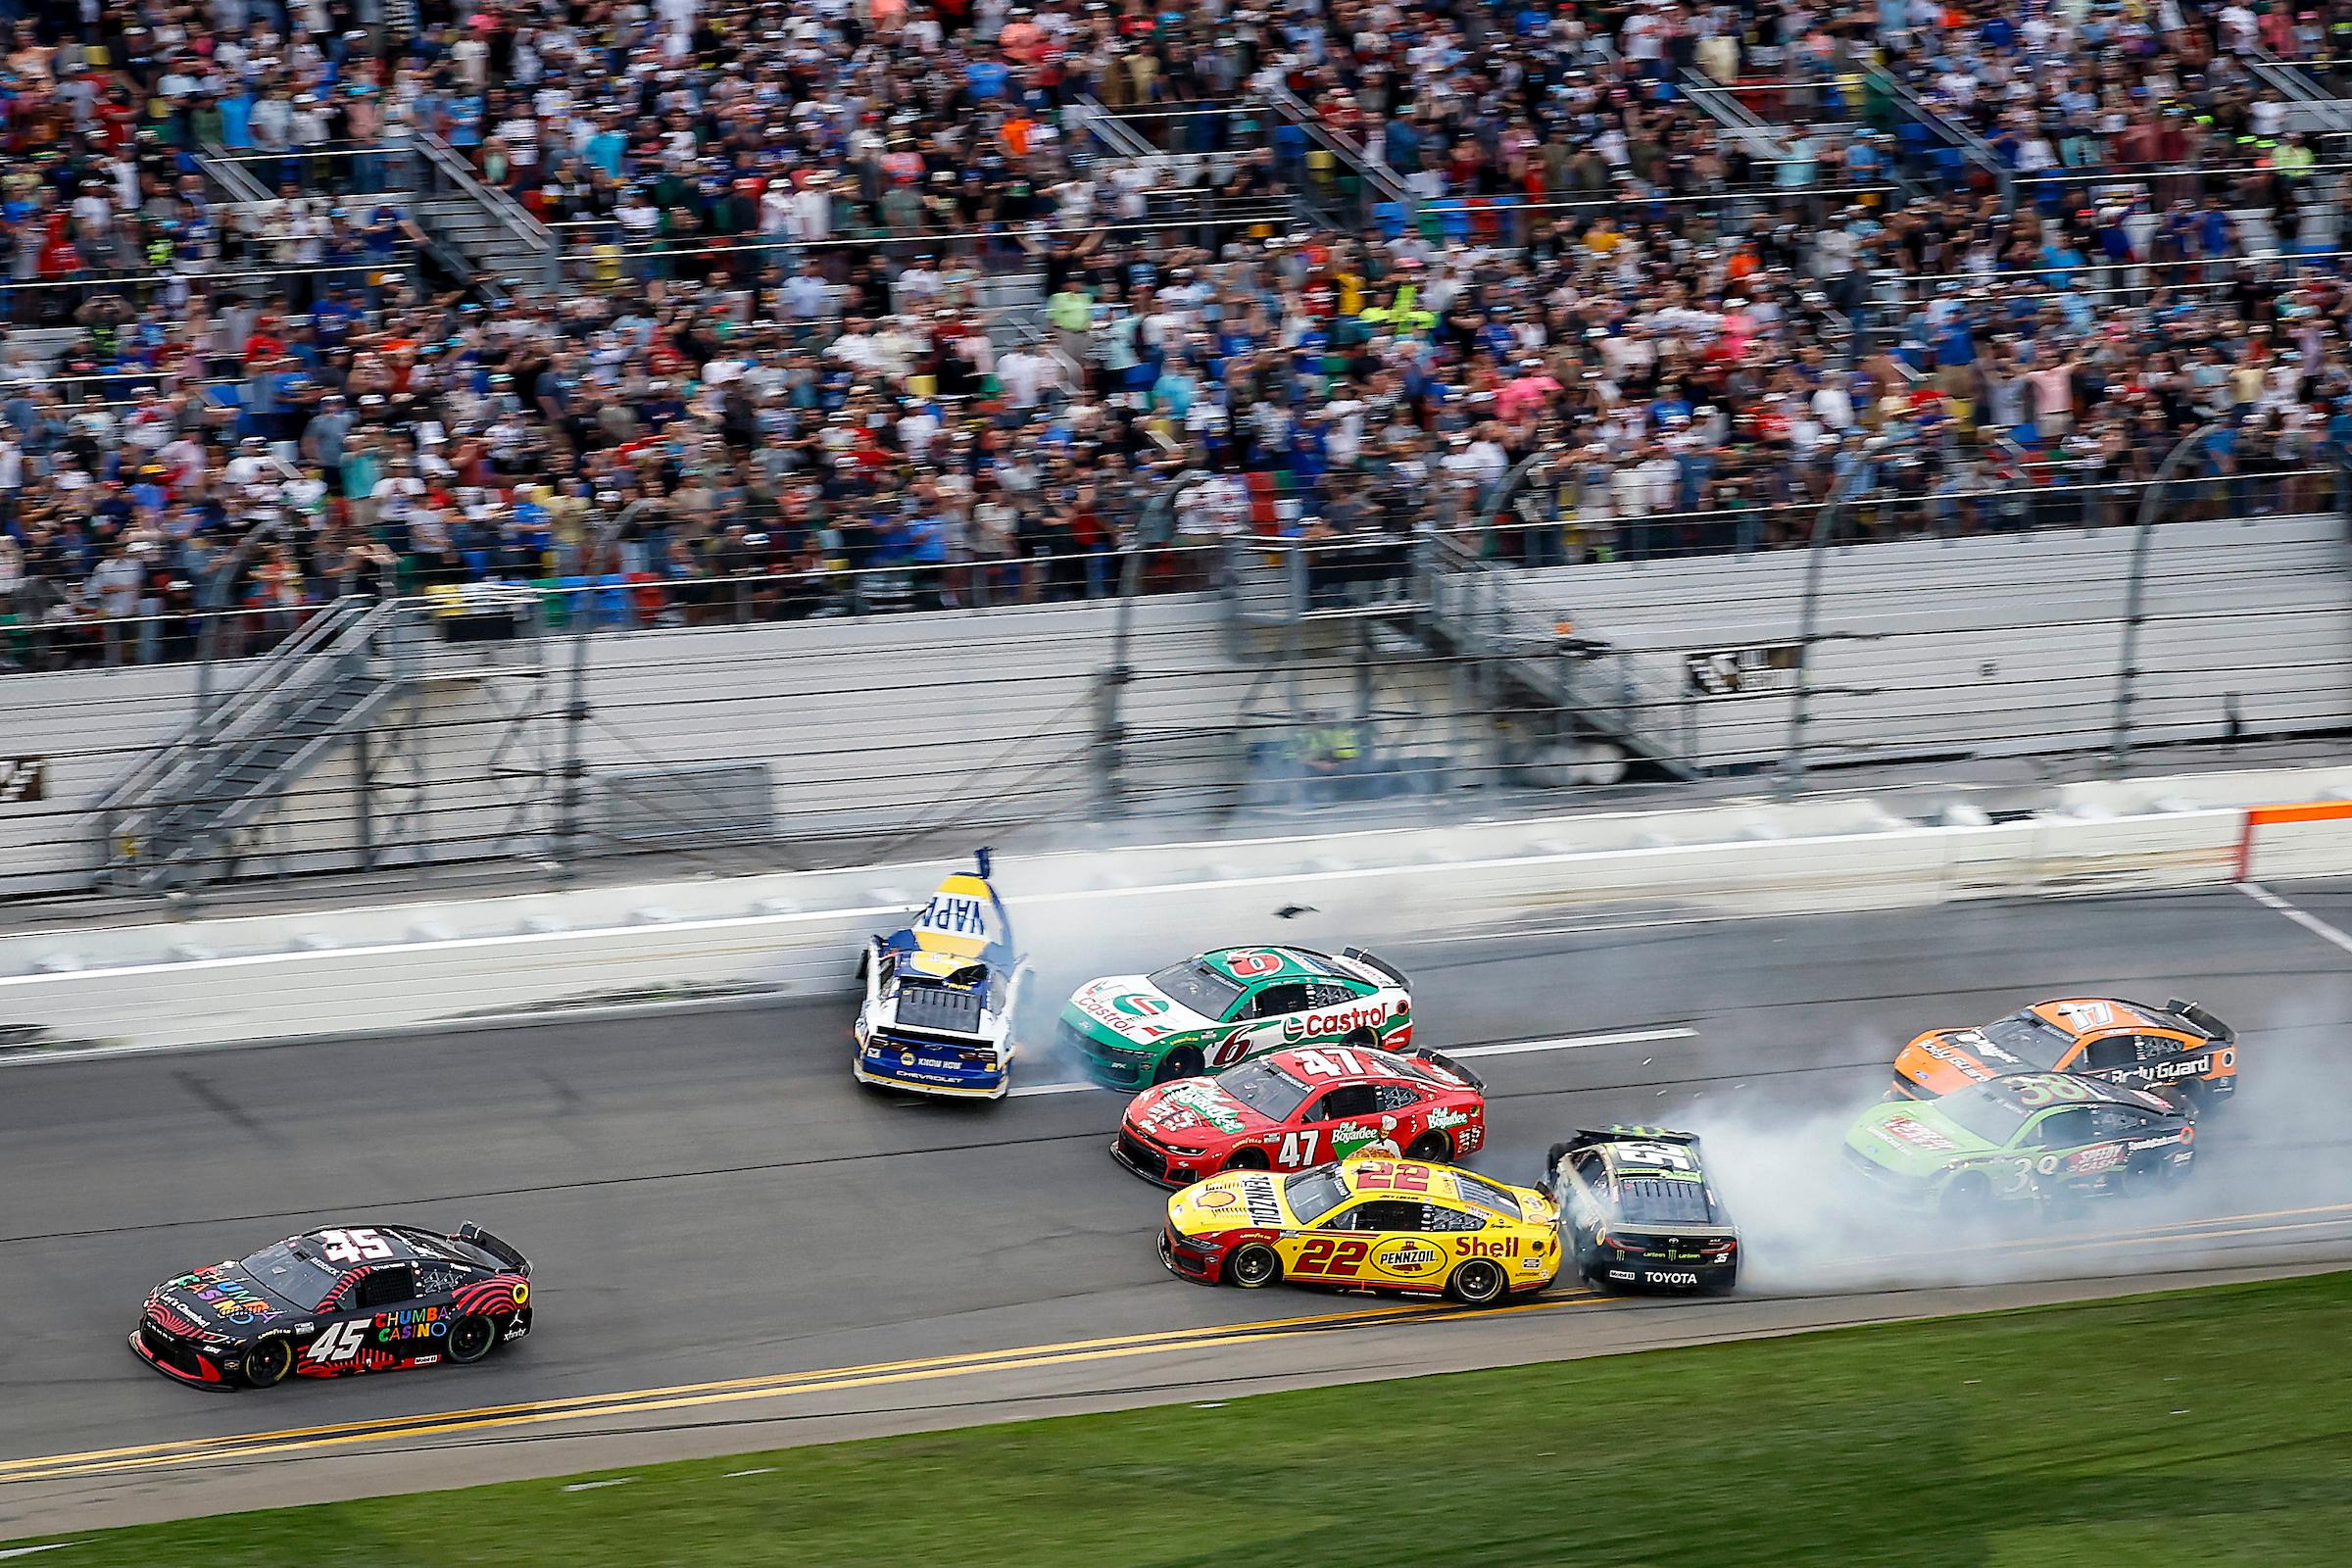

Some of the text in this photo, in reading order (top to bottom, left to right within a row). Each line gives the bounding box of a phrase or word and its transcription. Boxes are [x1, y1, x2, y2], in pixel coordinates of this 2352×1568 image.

[1077, 997, 1134, 1036] Castrol
[1306, 1003, 1388, 1036] Castrol
[1212, 1024, 1257, 1067] 6
[1296, 1048, 1365, 1077] 47
[896, 1070, 964, 1084] CHEVROLET
[1426, 1109, 1468, 1130] Boyardee
[1331, 1125, 1378, 1145] Boyardee
[1278, 1130, 1320, 1168] 47
[1355, 1161, 1430, 1192] 22
[318, 1229, 394, 1264] 45
[1293, 1239, 1369, 1276] 22
[1380, 1250, 1437, 1265] PENNZOIL
[1455, 1236, 1519, 1258] Shell
[310, 1256, 340, 1276] REDDICK
[1645, 1271, 1698, 1285] TOYOTA
[176, 1301, 212, 1328] Chumba!
[375, 1305, 450, 1328] CHUMBA
[307, 1318, 372, 1363] 45
[378, 1321, 448, 1343] CASINO
[503, 1327, 527, 1342] xfinity
